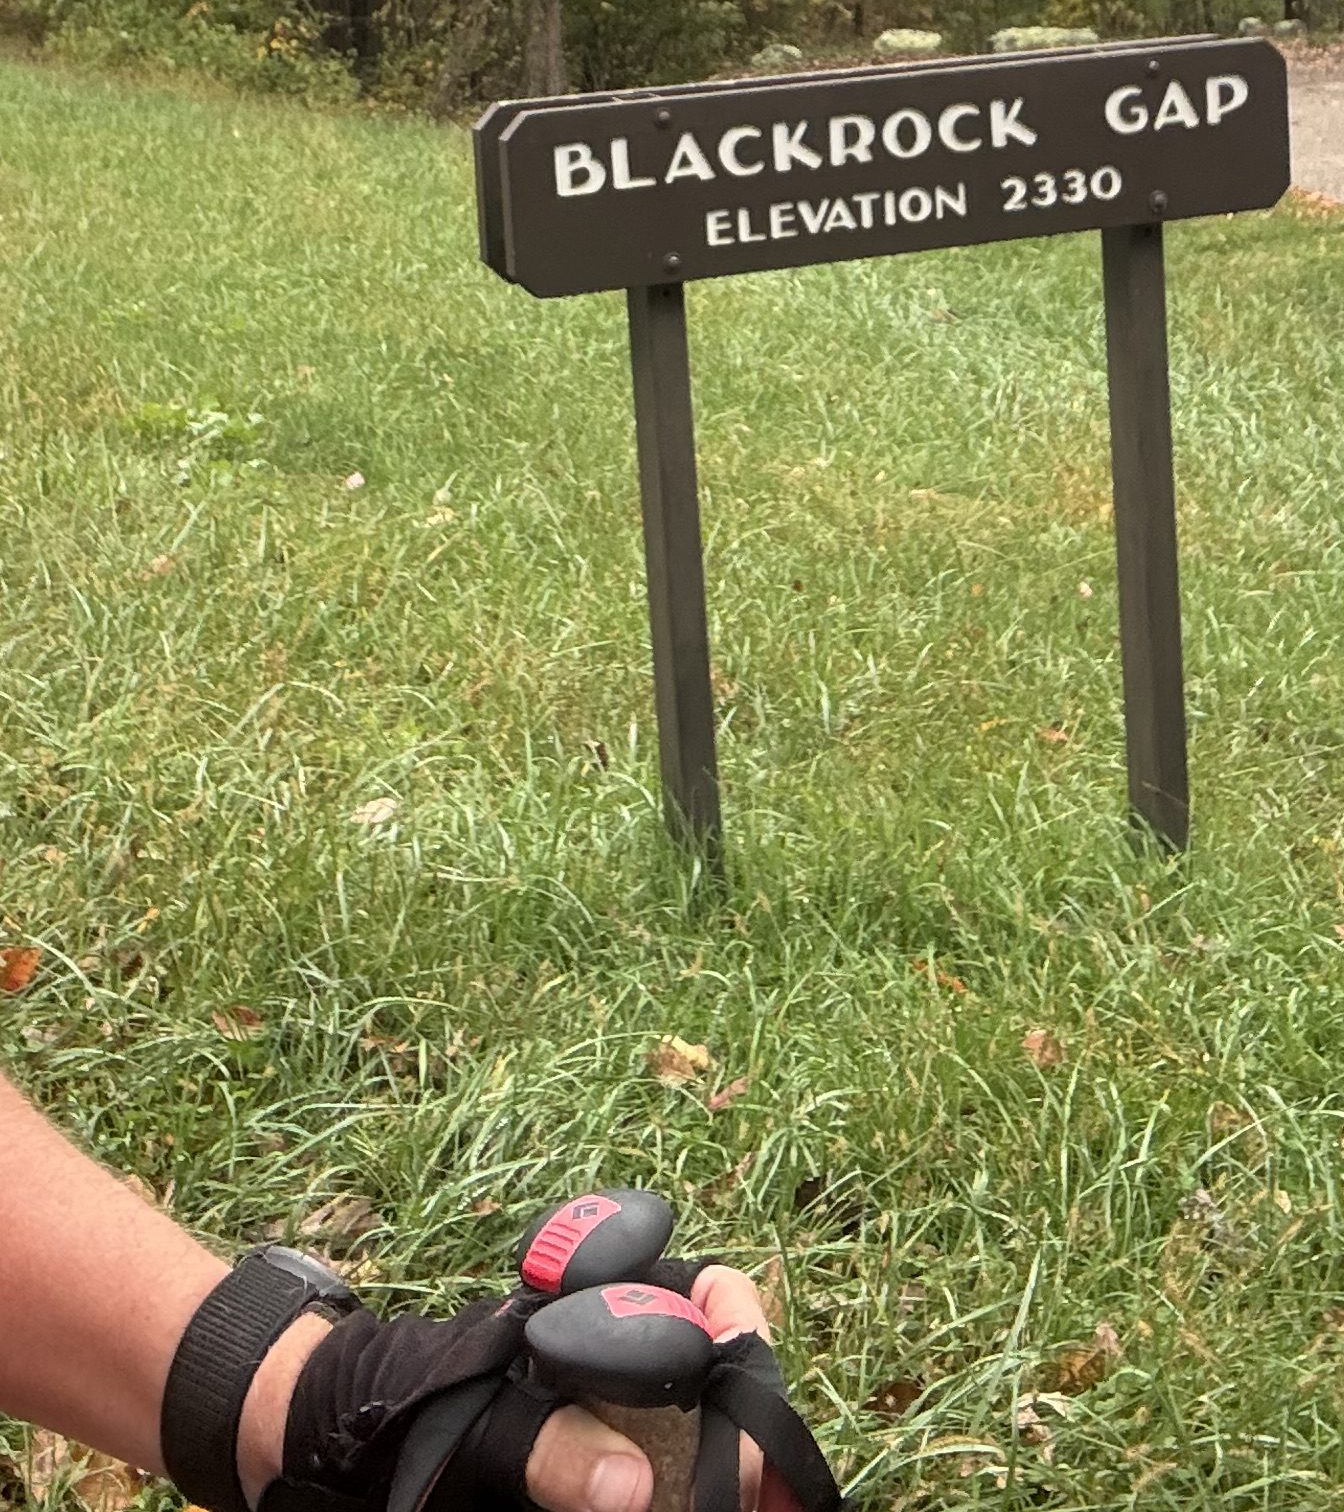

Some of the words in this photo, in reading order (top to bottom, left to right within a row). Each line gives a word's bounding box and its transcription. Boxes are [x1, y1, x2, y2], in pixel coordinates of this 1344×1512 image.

[553, 97, 1039, 199] BLACKROCK
[1103, 74, 1250, 136] GAP
[705, 181, 968, 248] ELEVATION
[1000, 165, 1123, 212] 2330
